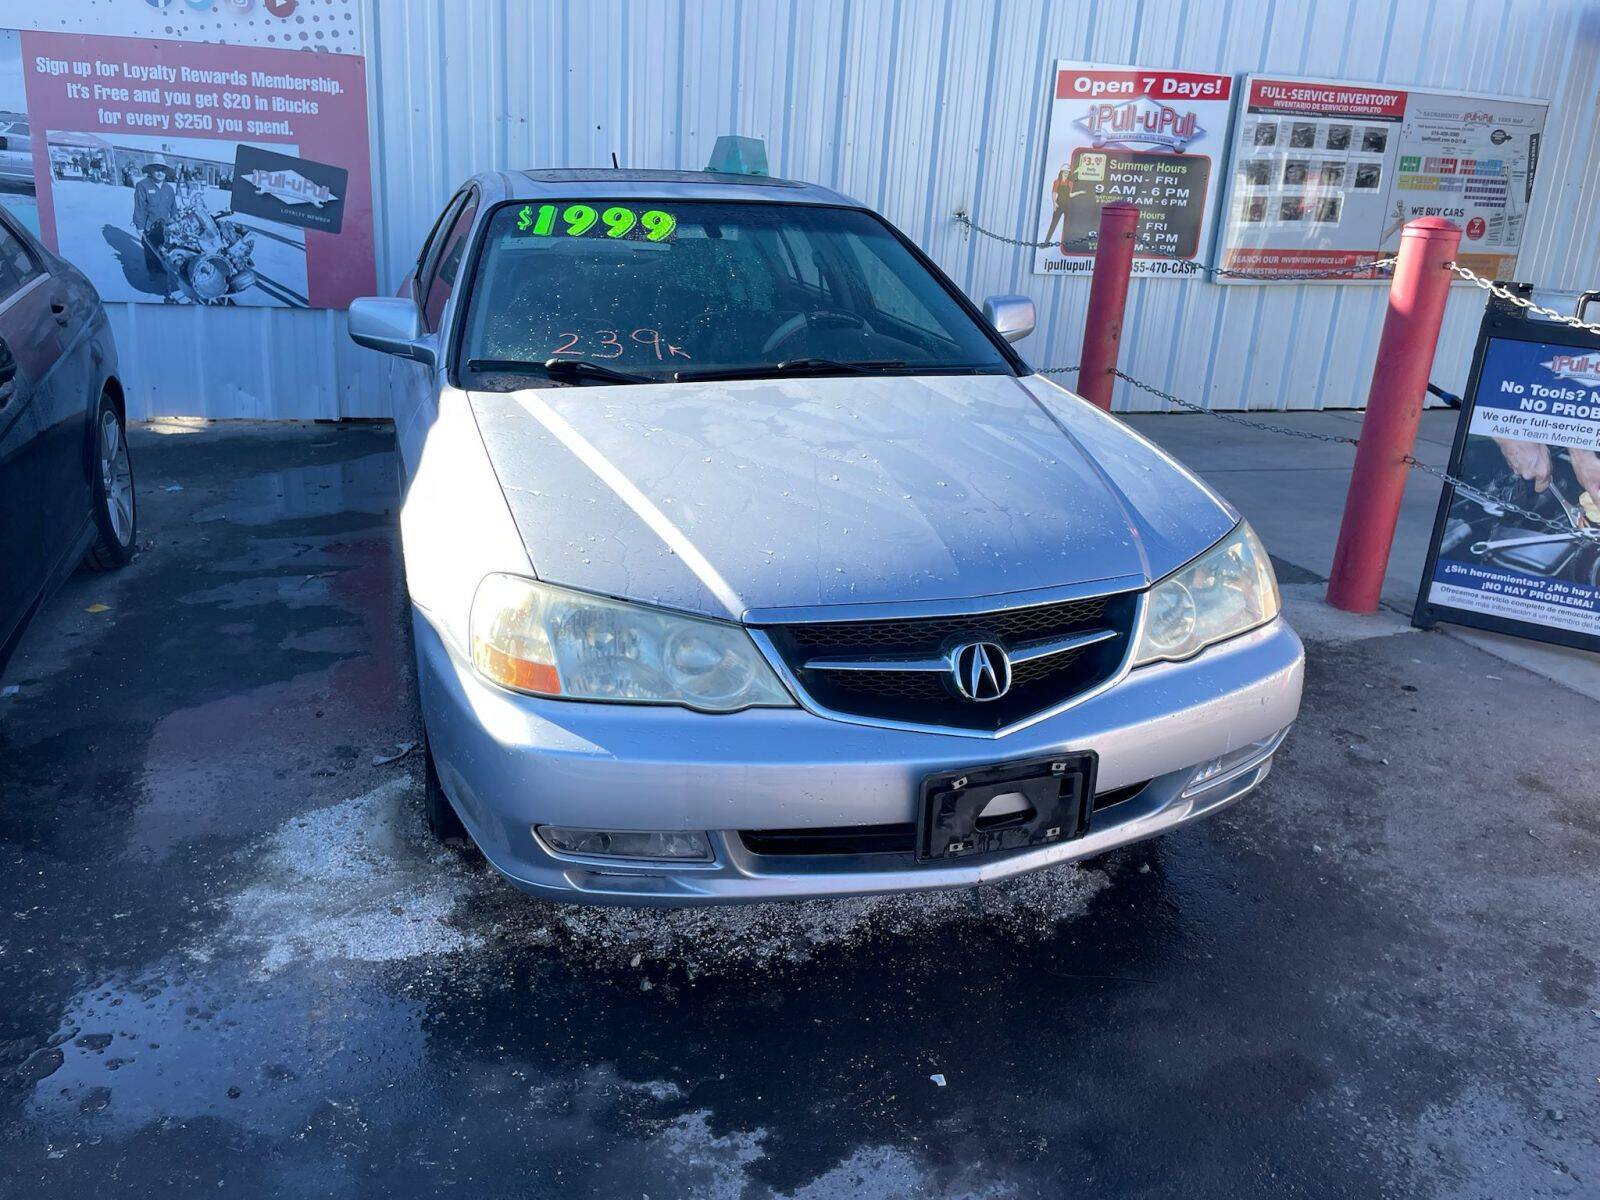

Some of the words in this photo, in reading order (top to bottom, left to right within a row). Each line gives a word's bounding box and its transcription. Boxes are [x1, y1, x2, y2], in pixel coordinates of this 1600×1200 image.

[35, 56, 69, 76] Sign
[73, 60, 91, 77] up
[95, 60, 119, 77] for
[123, 62, 177, 83] Loyalty
[181, 66, 248, 86] Rewards
[251, 71, 344, 95] Membership.
[1074, 77, 1135, 96] Open
[1143, 78, 1156, 93] 7
[1162, 79, 1222, 97] Days!
[1260, 86, 1334, 104] FULL-SERVICE
[1337, 93, 1399, 106] INVENTORY
[67, 82, 90, 99] It's
[94, 84, 129, 101] Free
[133, 88, 160, 104] and
[164, 91, 191, 106] you
[195, 93, 219, 109] get
[223, 92, 251, 110] $20
[255, 95, 269, 111] in
[271, 96, 319, 115] iBucks
[1273, 100, 1311, 110] INVENTARIO
[1322, 104, 1349, 112] SERVICIO
[1350, 106, 1382, 114] COMPLETO
[98, 108, 121, 124] for
[126, 112, 170, 130] every
[174, 111, 213, 131] $250
[217, 117, 243, 133] you
[246, 120, 294, 136] spend.
[1109, 160, 1154, 173] Summer
[1156, 162, 1188, 174] Hours
[1110, 173, 1143, 184] MON
[1155, 176, 1178, 185] FRI
[1095, 184, 1105, 193] 9
[1108, 185, 1137, 195] AM
[1151, 187, 1160, 196] 6
[1165, 188, 1190, 198] PM
[1134, 197, 1153, 205] AM
[1161, 198, 1168, 206] 6
[1169, 199, 1187, 207] PM
[1411, 206, 1424, 216] WE
[1425, 207, 1442, 216] BUY
[1443, 208, 1464, 217] CARS
[517, 204, 677, 242] $1999
[1139, 210, 1166, 220] Hours
[1145, 222, 1168, 231] FRI
[1142, 233, 1152, 242] 5
[1154, 233, 1179, 243] PM
[1130, 260, 1198, 275] 55-470-CASH
[1263, 256, 1279, 264] OUR
[1501, 381, 1524, 394] No
[1530, 384, 1586, 402] Tools?
[1520, 398, 1547, 412] NO
[1552, 402, 1600, 419] PROB
[1482, 411, 1499, 421] We
[1502, 414, 1528, 425] offer
[1530, 418, 1593, 434] full-service
[1492, 425, 1510, 434] Ask
[1523, 428, 1549, 440] Team
[1551, 433, 1593, 446] Member
[1445, 564, 1467, 574] ¿Sin
[1470, 568, 1546, 589] herramientas?
[1547, 583, 1570, 593] ¿No
[1572, 587, 1592, 598] hay
[1440, 586, 1479, 599] Ofrecemos
[1480, 594, 1510, 604] servicio
[1511, 601, 1545, 611] completo
[1557, 608, 1594, 621] remoción
[1481, 582, 1502, 592] ¡NO
[1504, 584, 1528, 596] HAY
[1529, 590, 1594, 609] PROBLEMA!
